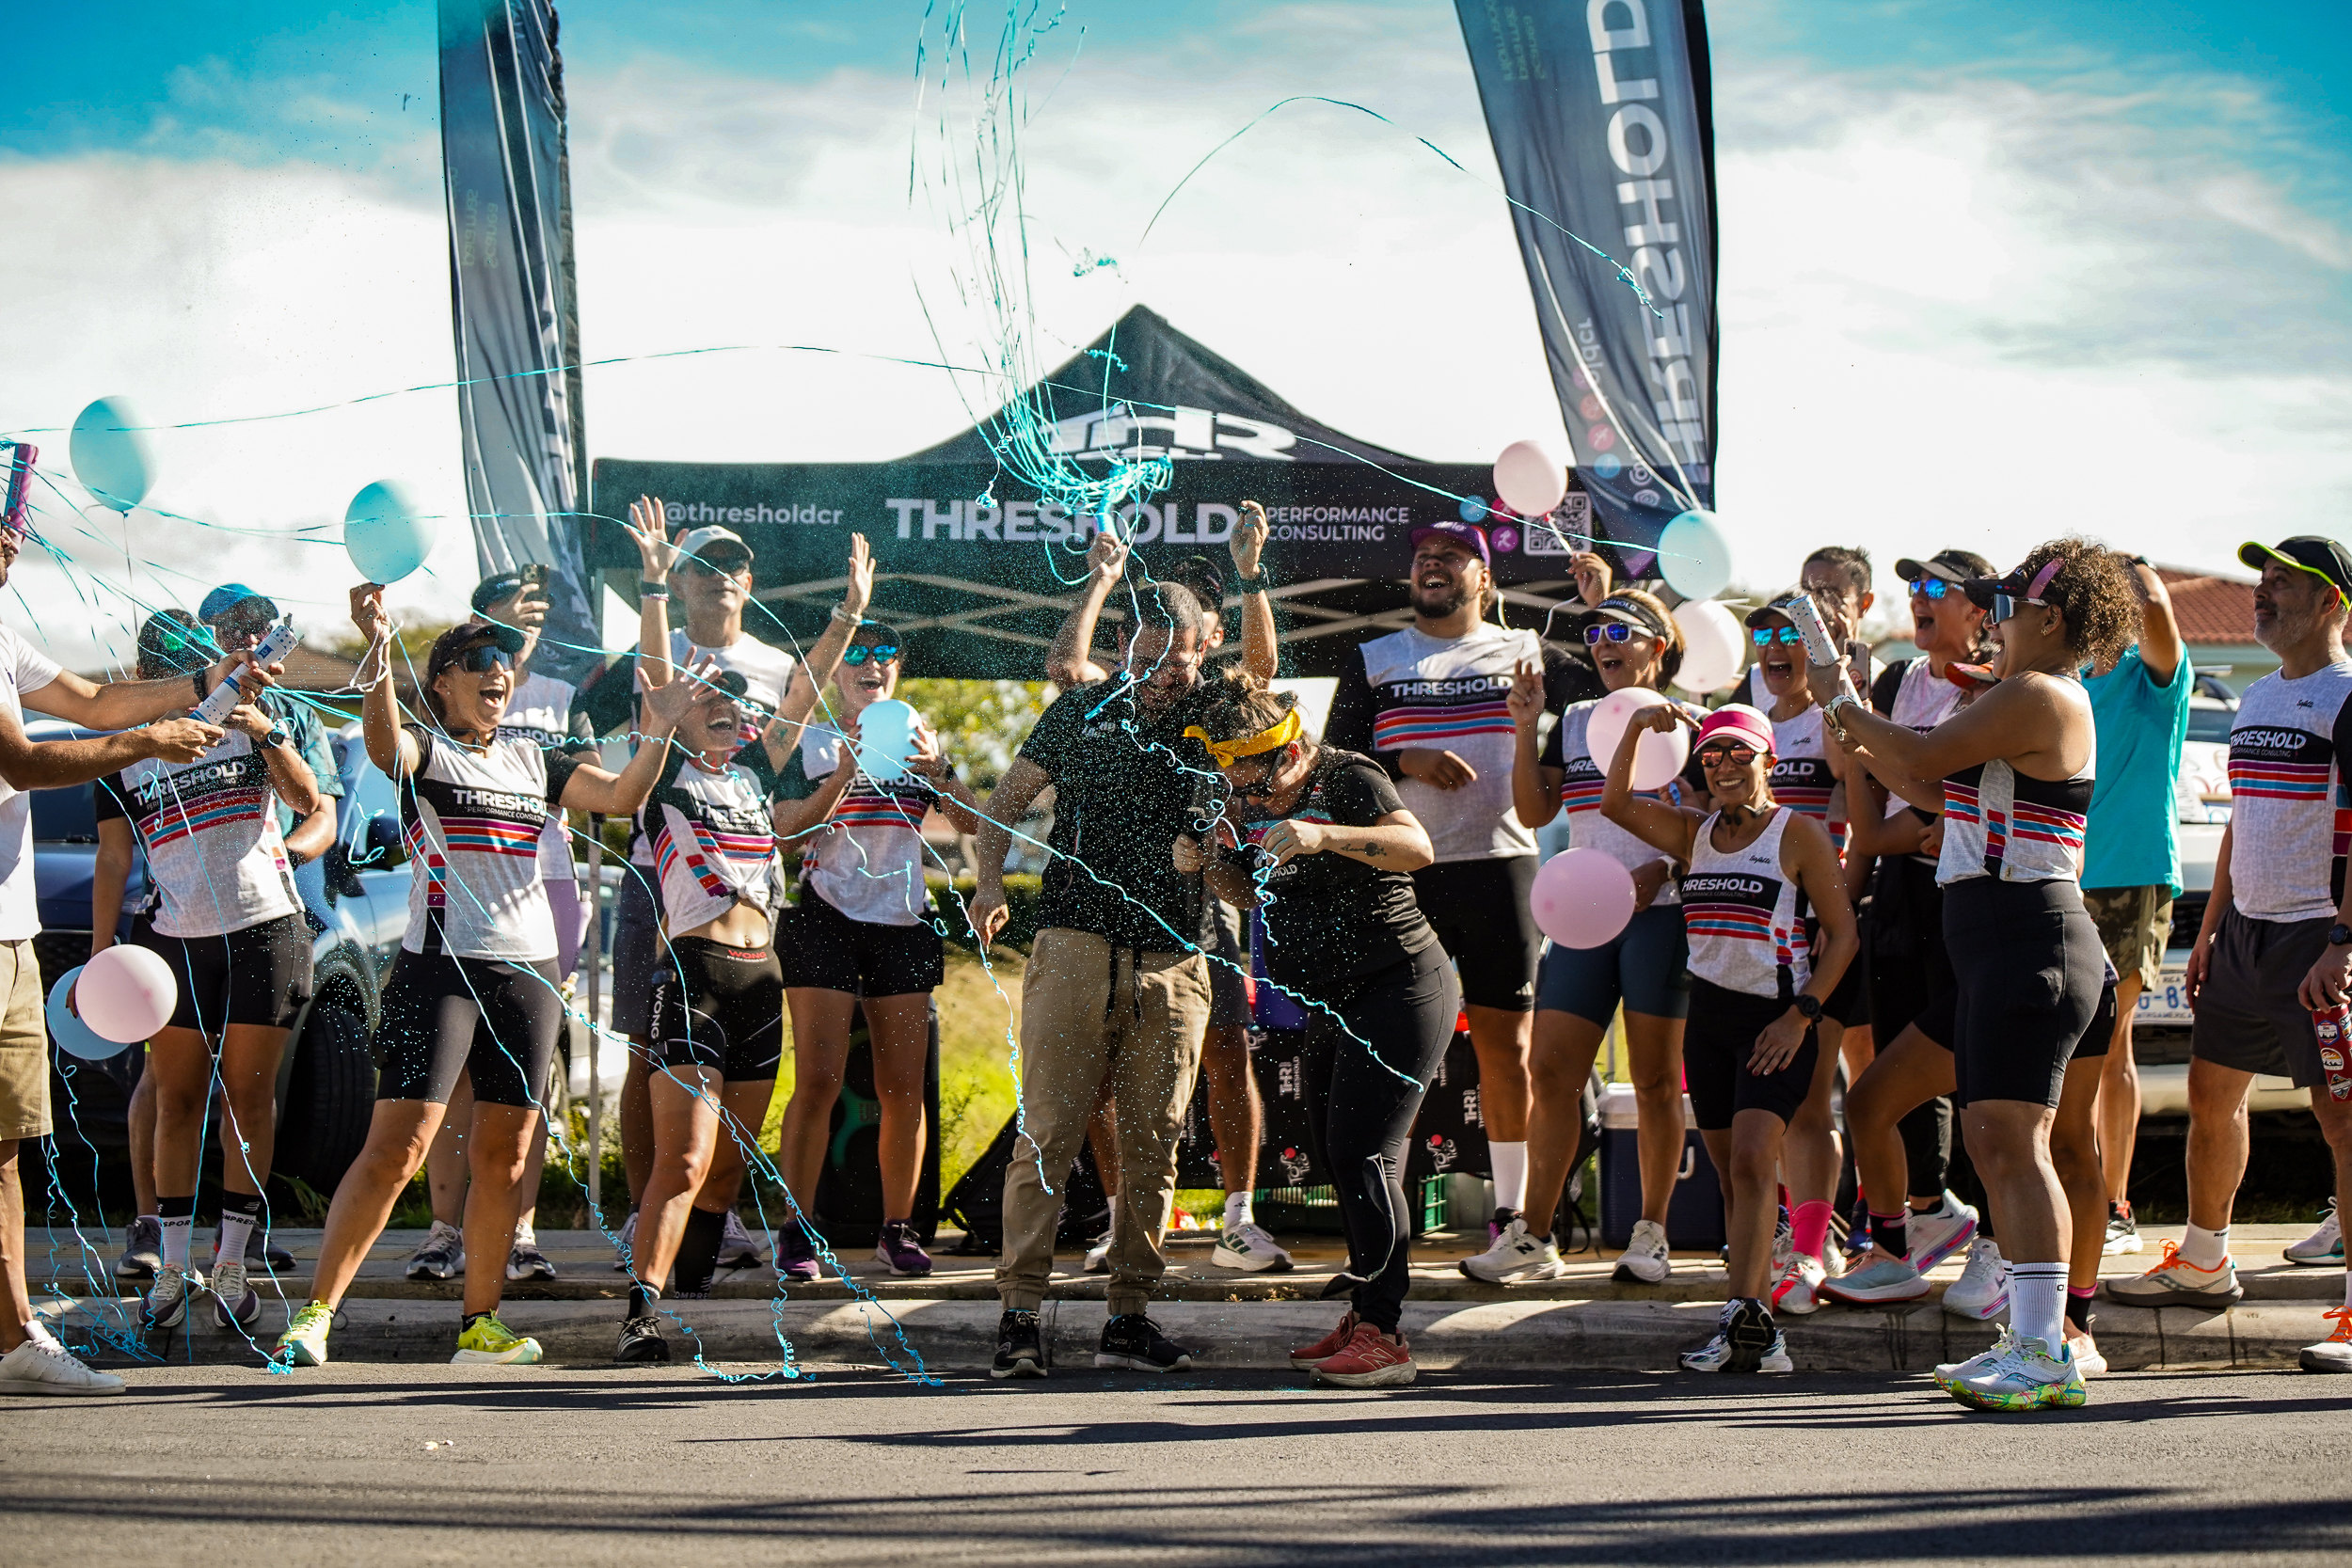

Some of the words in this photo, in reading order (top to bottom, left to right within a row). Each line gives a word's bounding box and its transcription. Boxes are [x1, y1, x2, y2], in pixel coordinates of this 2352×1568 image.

[664, 501, 845, 527] @thresholdcr
[884, 497, 1240, 545] THRESHOLD
[1265, 506, 1410, 523] PERFORMANCE
[1268, 524, 1386, 541] CONSULTING
[1391, 675, 1515, 698] THRESHOLD
[496, 728, 565, 748] ESHOLD
[2230, 730, 2308, 750] THRESHOLD
[134, 760, 247, 806] THRESHOLD
[453, 788, 547, 816] THRESHOL
[467, 806, 515, 818] PERFORMANCE
[1682, 878, 1764, 894] HRESHOLD
[727, 949, 767, 958] WONG
[650, 984, 666, 1039] WONG
[1438, 1055, 1448, 1087] THRES
[160, 1219, 192, 1227] SPOR
[222, 1213, 256, 1226] MPRES
[674, 1291, 710, 1299] OMPRE
